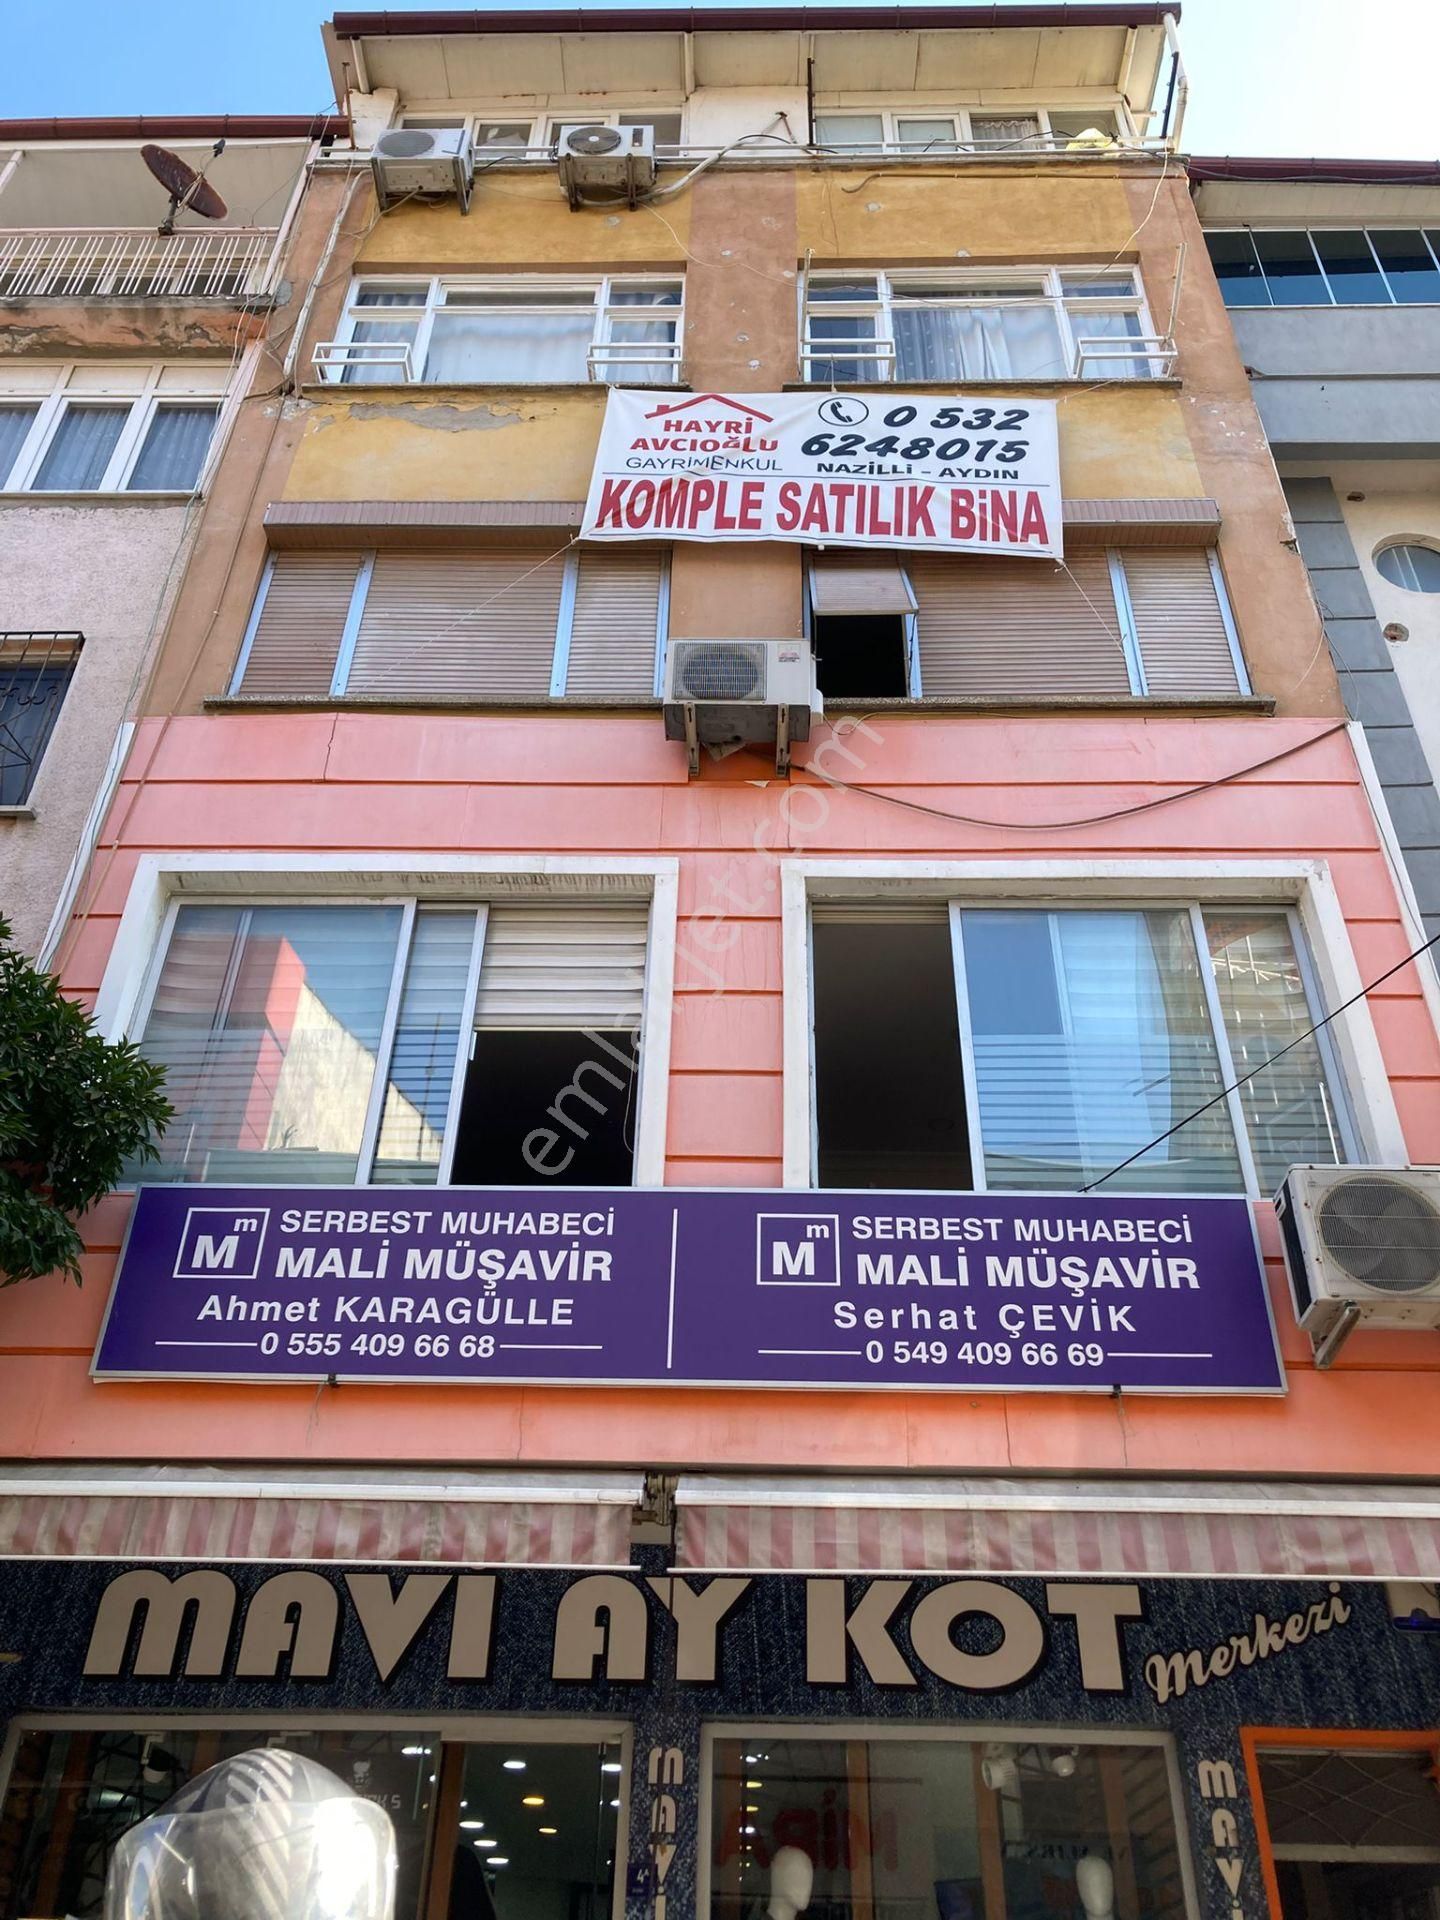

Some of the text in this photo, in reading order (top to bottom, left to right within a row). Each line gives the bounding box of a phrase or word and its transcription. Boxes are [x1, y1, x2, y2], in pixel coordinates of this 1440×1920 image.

[884, 406, 1030, 431] 0 532
[801, 433, 1029, 462] 6248015
[626, 455, 783, 471] GAYRİMENKUL
[939, 468, 1019, 479] AYDIN
[595, 478, 765, 530] KOMPLE
[776, 482, 936, 537] SATILIK
[280, 1207, 614, 1236] SERBEST MUHABECİ
[852, 1214, 1192, 1243] SERBEST MUHABECİ
[275, 1239, 613, 1289] MALİ MÜŞAVİR
[857, 1247, 1201, 1297] MALİ MÜŞAVİR
[197, 1291, 574, 1325] Ahmet KARAGÜLLE
[834, 1299, 1137, 1338] Serhat ÇEVİK
[260, 1332, 495, 1358] 0 555 409 66 68
[866, 1341, 1104, 1367] 0 549 409 66 69
[82, 1569, 1351, 1704] MAVI AY KOT Merkezi
